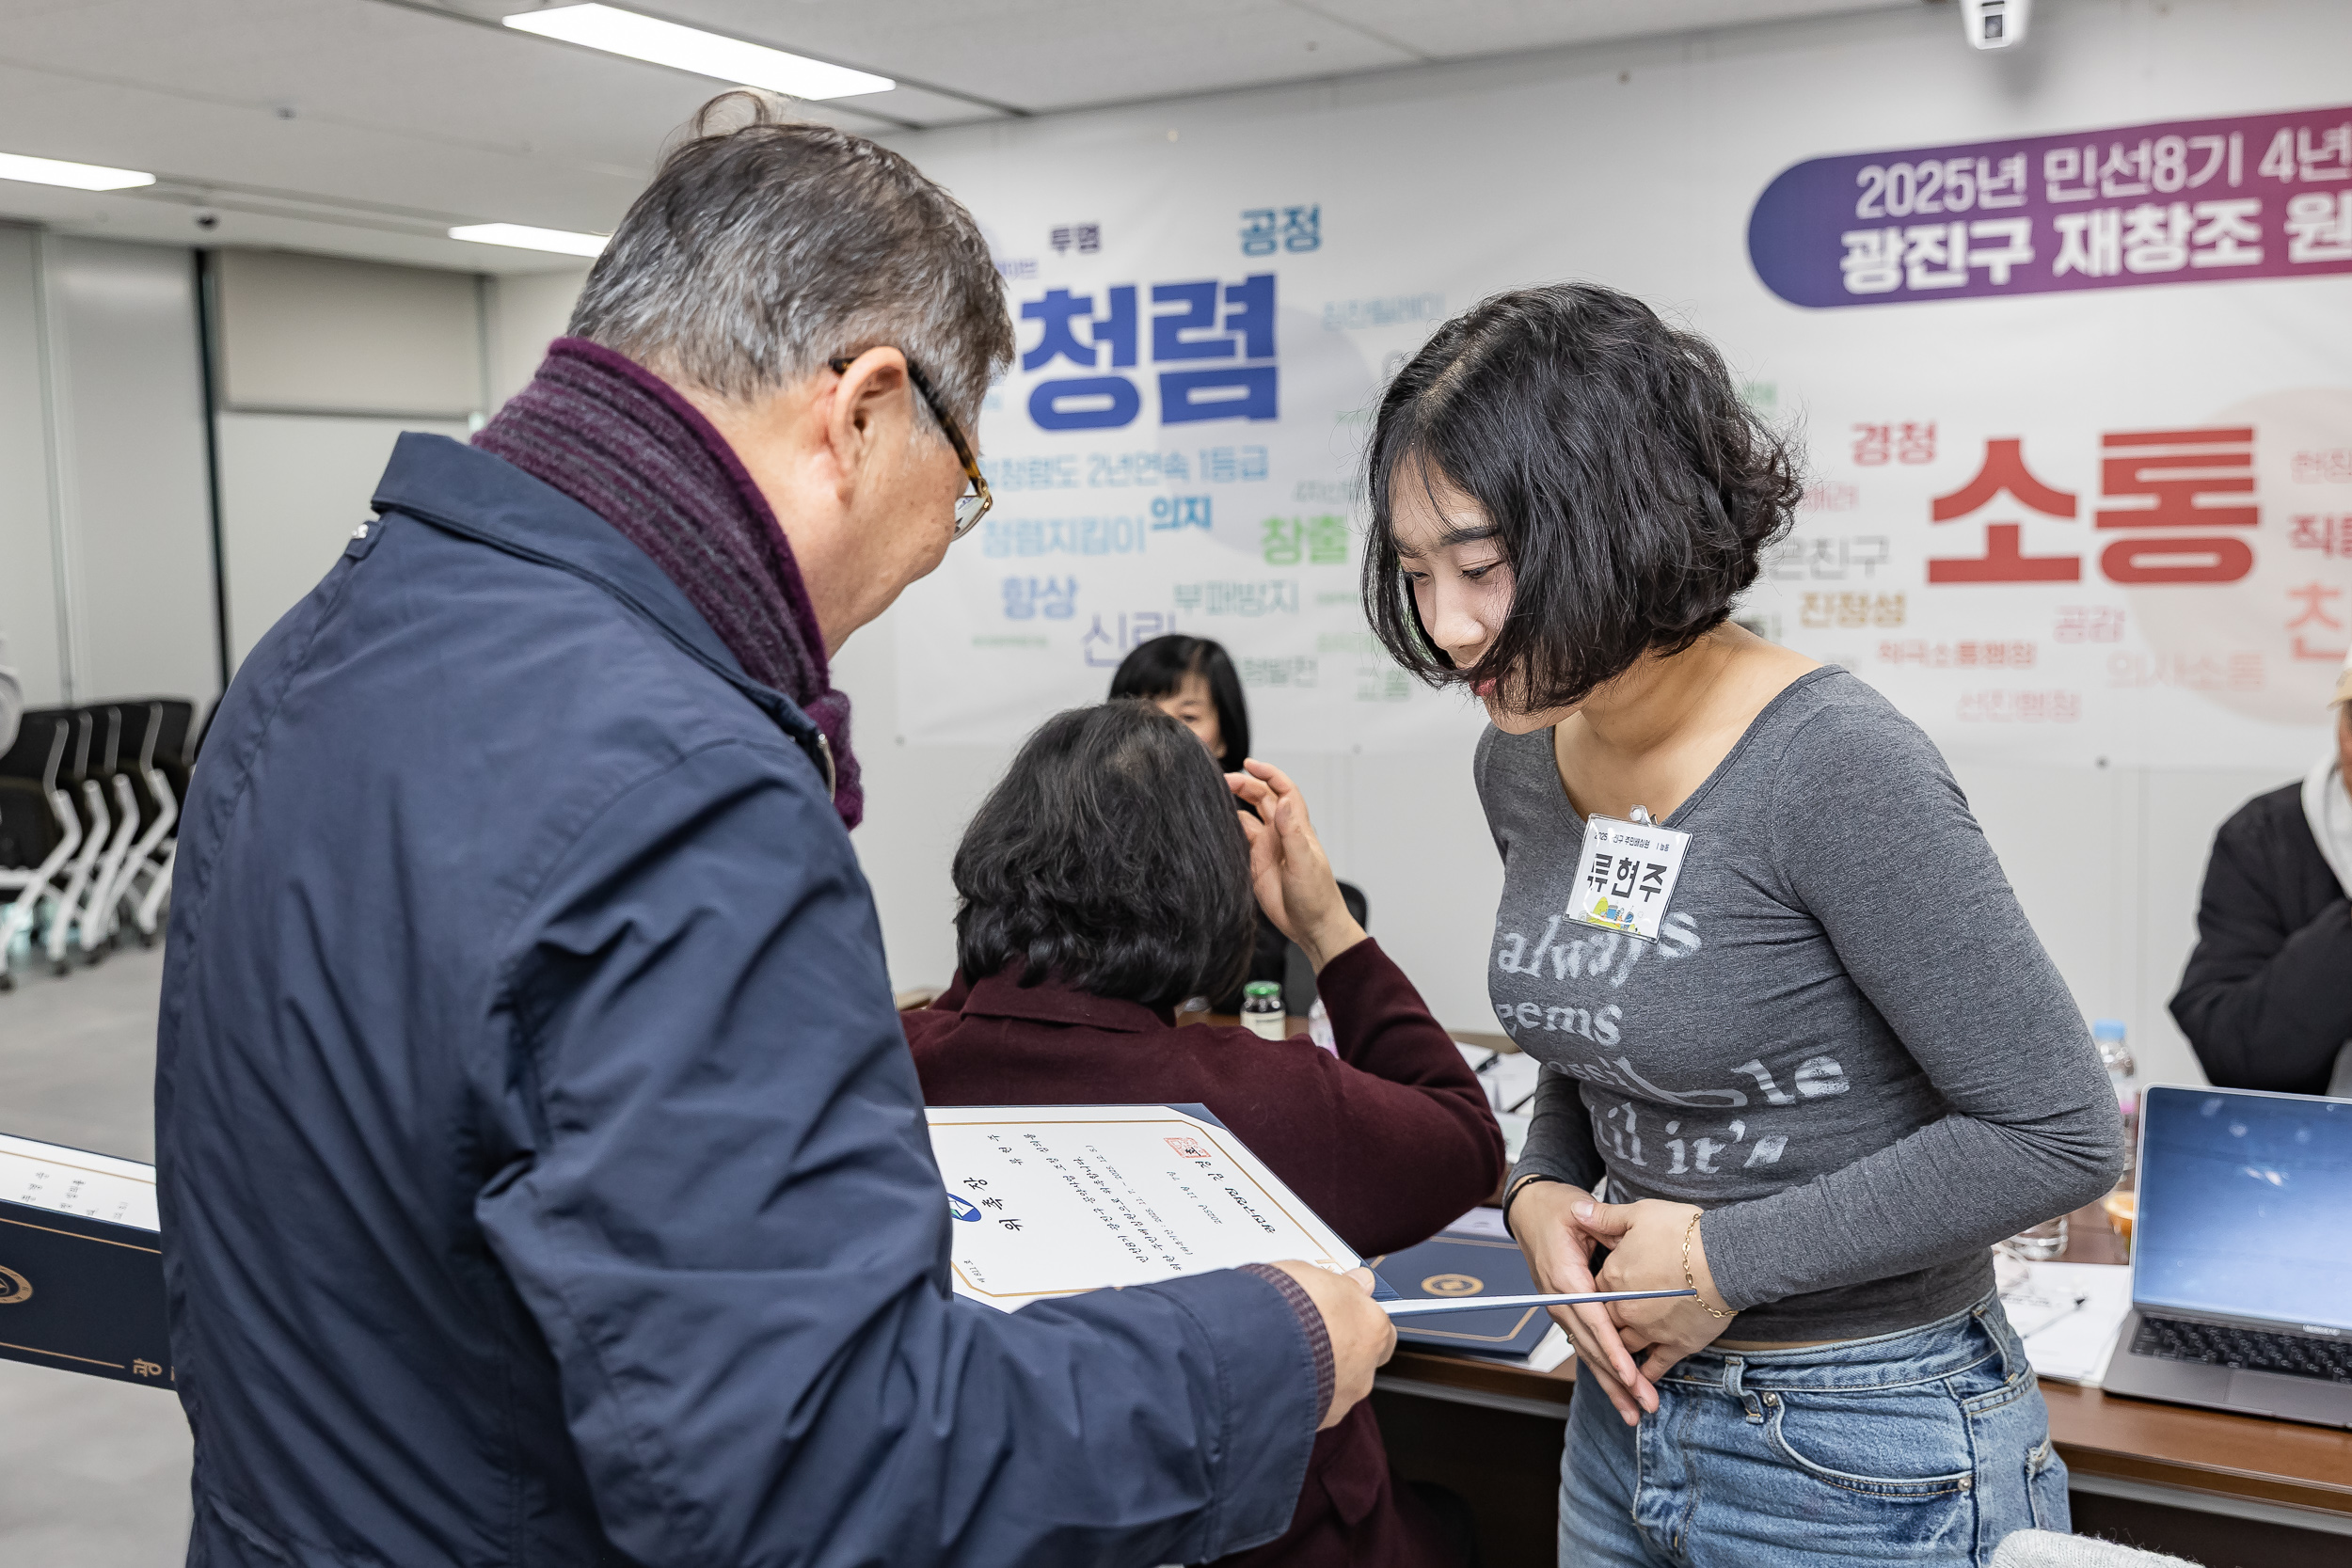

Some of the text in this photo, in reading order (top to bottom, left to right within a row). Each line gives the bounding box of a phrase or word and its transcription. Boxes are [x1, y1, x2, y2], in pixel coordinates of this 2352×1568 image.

[1855, 122, 2352, 219] 2025년 민선8기 4년
[1050, 224, 1101, 254] 투명
[1240, 204, 1321, 257] 공정
[1841, 218, 2034, 293] 광진구
[2054, 198, 2264, 277] 재창조
[1021, 273, 1279, 431] 청렴
[1852, 420, 1937, 466] 경청
[1088, 452, 1190, 487] 2년연속
[1199, 445, 1269, 483] 1등급
[1151, 495, 1212, 531] 의지
[1927, 426, 2263, 586] 소통
[983, 515, 1146, 558] 청렴지킴이
[1262, 515, 1350, 565] 창출
[1173, 580, 1298, 616] 부패방지
[1800, 592, 1907, 629] 진정성
[2054, 607, 2125, 643] 공감
[2107, 653, 2267, 690] 의사소통
[1625, 835, 1651, 849] 주민배심원
[1587, 853, 1667, 903] 류현주
[1062, 1175, 1096, 1204] 공약사업
[1092, 1207, 1120, 1231] 광진구
[1110, 1197, 1164, 1251] 주민배심원으로
[1198, 1204, 1223, 1225] 2025년
[1224, 1187, 1276, 1234] 광진구청장
[1117, 1235, 1150, 1263] 민선8기
[1162, 1254, 1182, 1272] 위한
